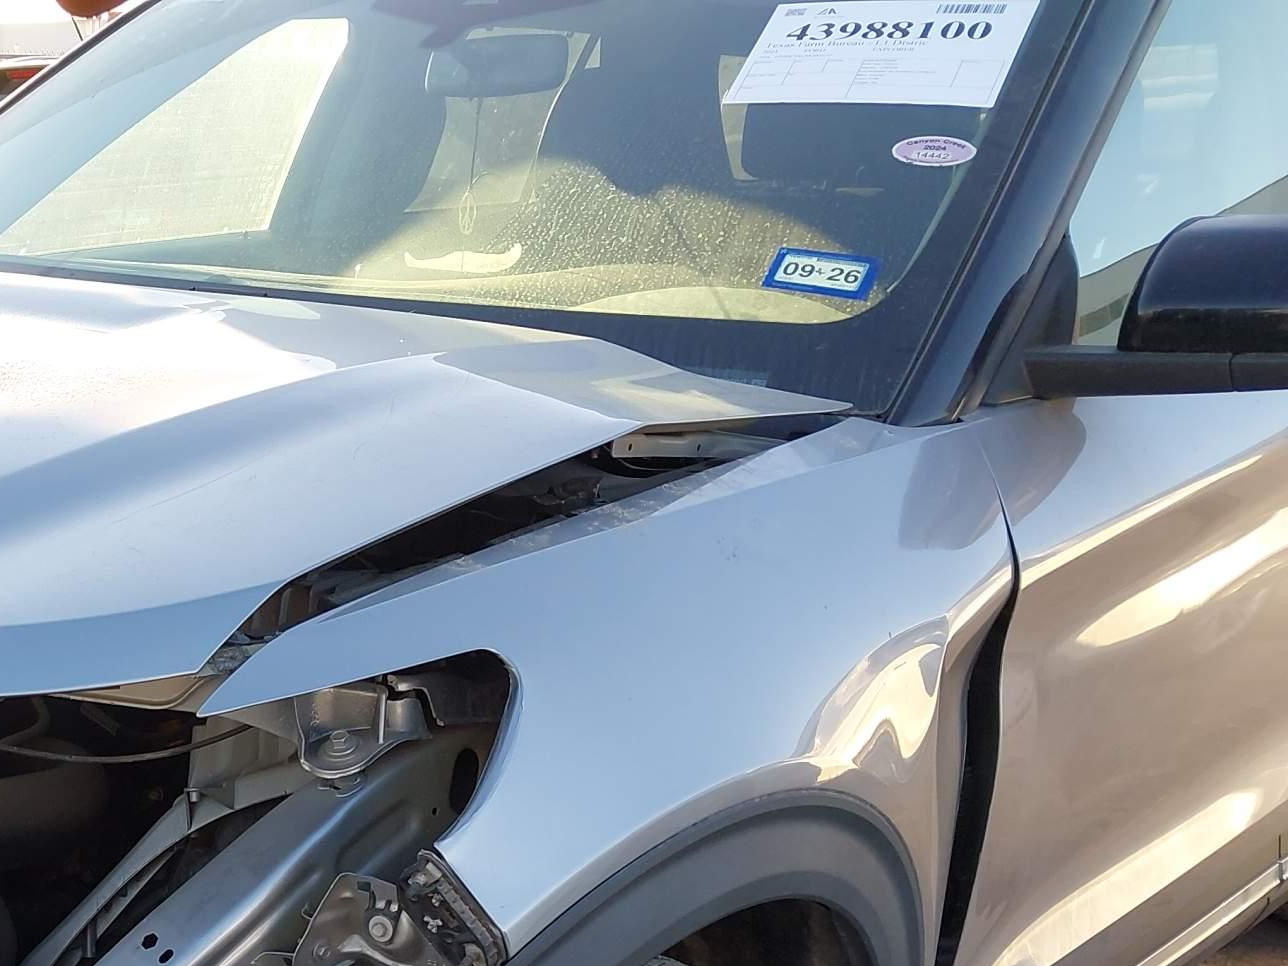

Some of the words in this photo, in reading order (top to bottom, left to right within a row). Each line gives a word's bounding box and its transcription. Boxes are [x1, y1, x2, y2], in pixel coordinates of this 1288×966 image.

[786, 20, 993, 41] 43988100
[917, 151, 950, 160] 14442
[782, 262, 815, 278] 09
[825, 267, 861, 284] 26
